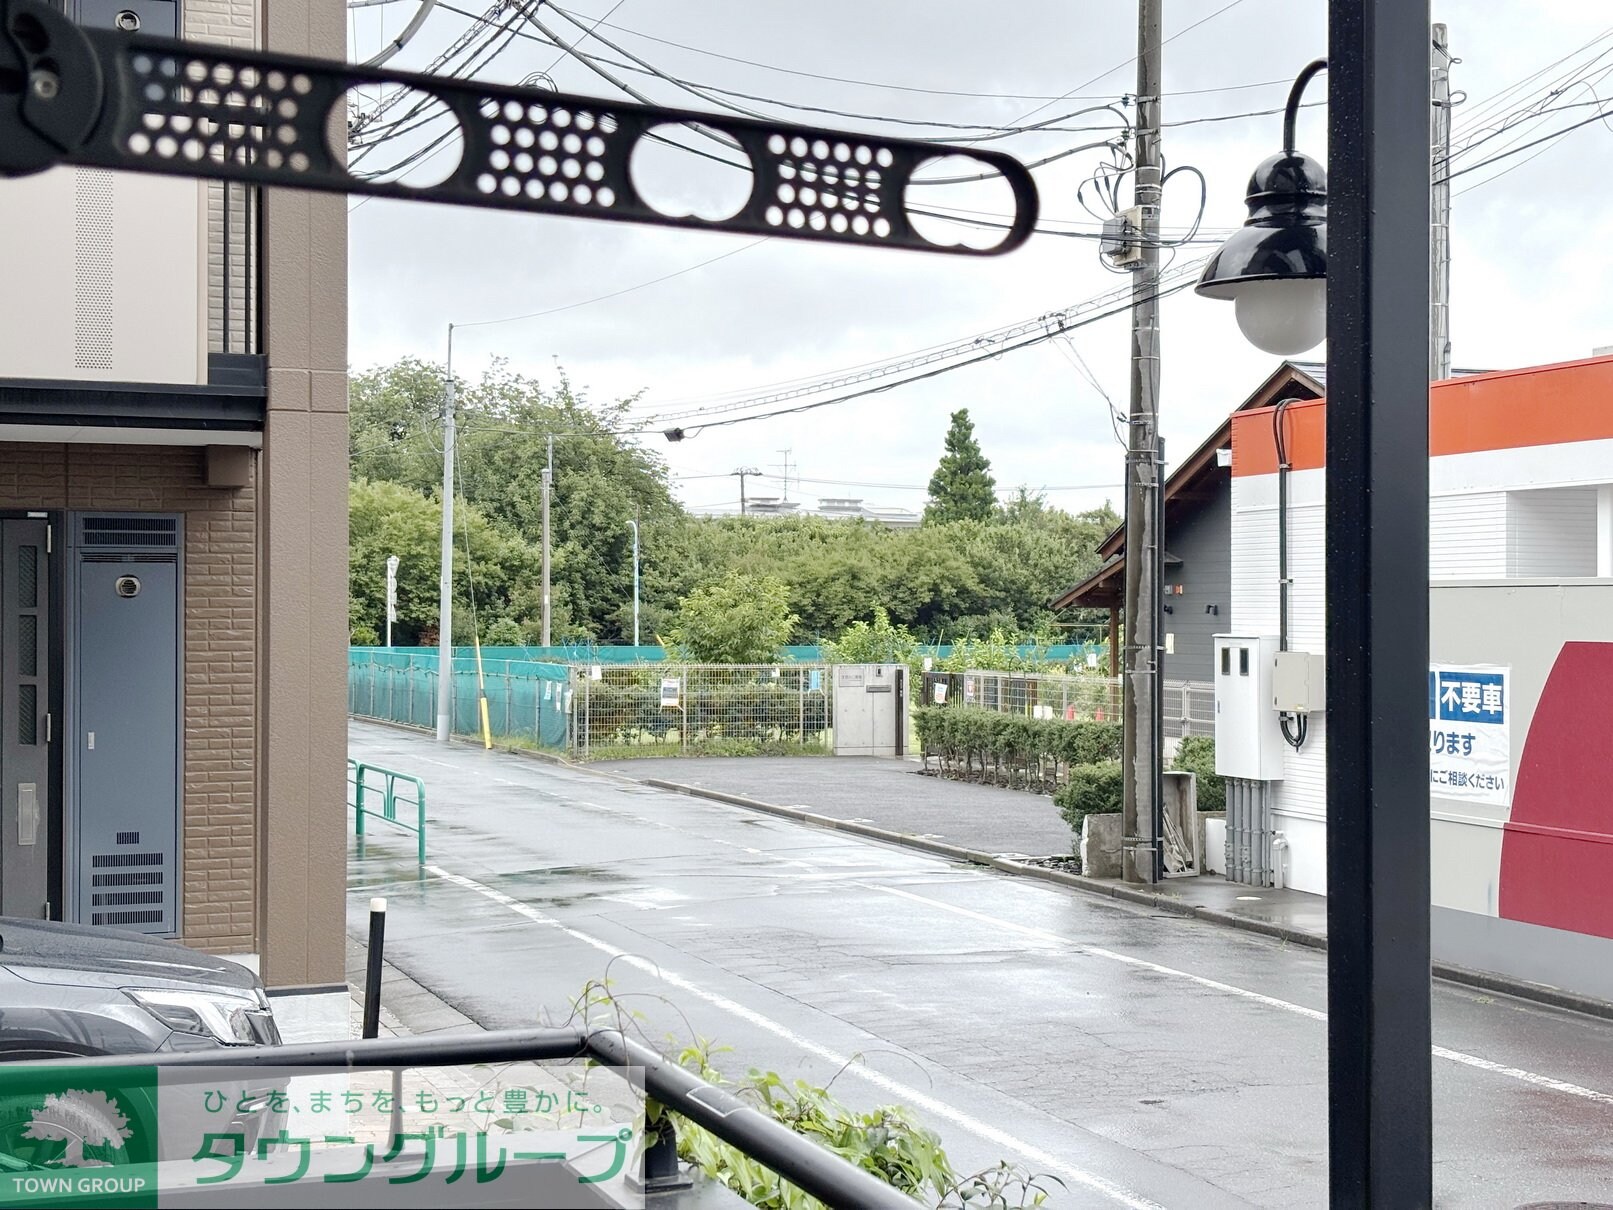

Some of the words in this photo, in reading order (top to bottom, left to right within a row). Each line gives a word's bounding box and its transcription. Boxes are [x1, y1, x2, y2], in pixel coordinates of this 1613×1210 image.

[1441, 681, 1502, 714] 不要車
[1430, 731, 1475, 756] ります
